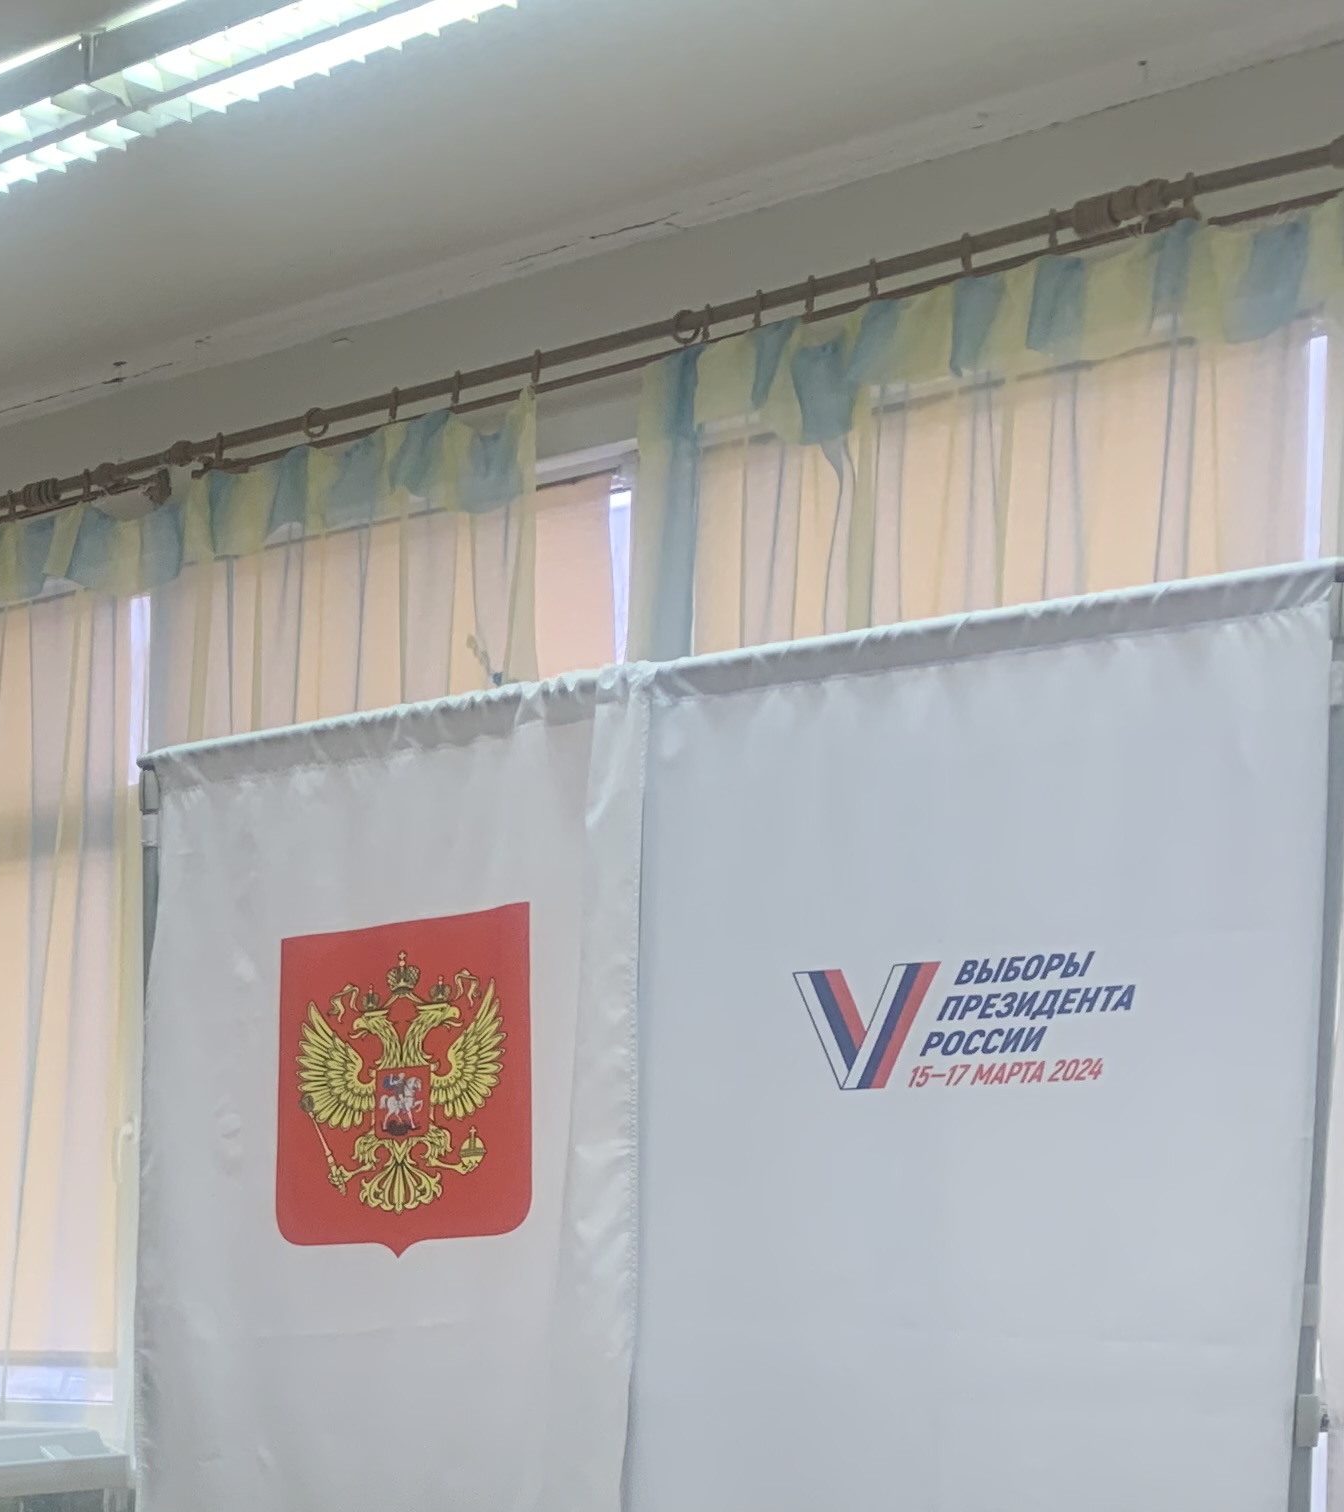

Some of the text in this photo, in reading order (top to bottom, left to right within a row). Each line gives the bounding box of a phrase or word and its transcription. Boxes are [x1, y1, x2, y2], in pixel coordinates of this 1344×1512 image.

[954, 951, 1096, 985] ВЫБОРЫ
[936, 984, 1136, 1021] ПРЕЗИДЕНТА
[919, 1026, 1048, 1057] РОССИИ
[971, 1060, 1045, 1086] МАРТА
[1048, 1057, 1104, 1083] 2024
